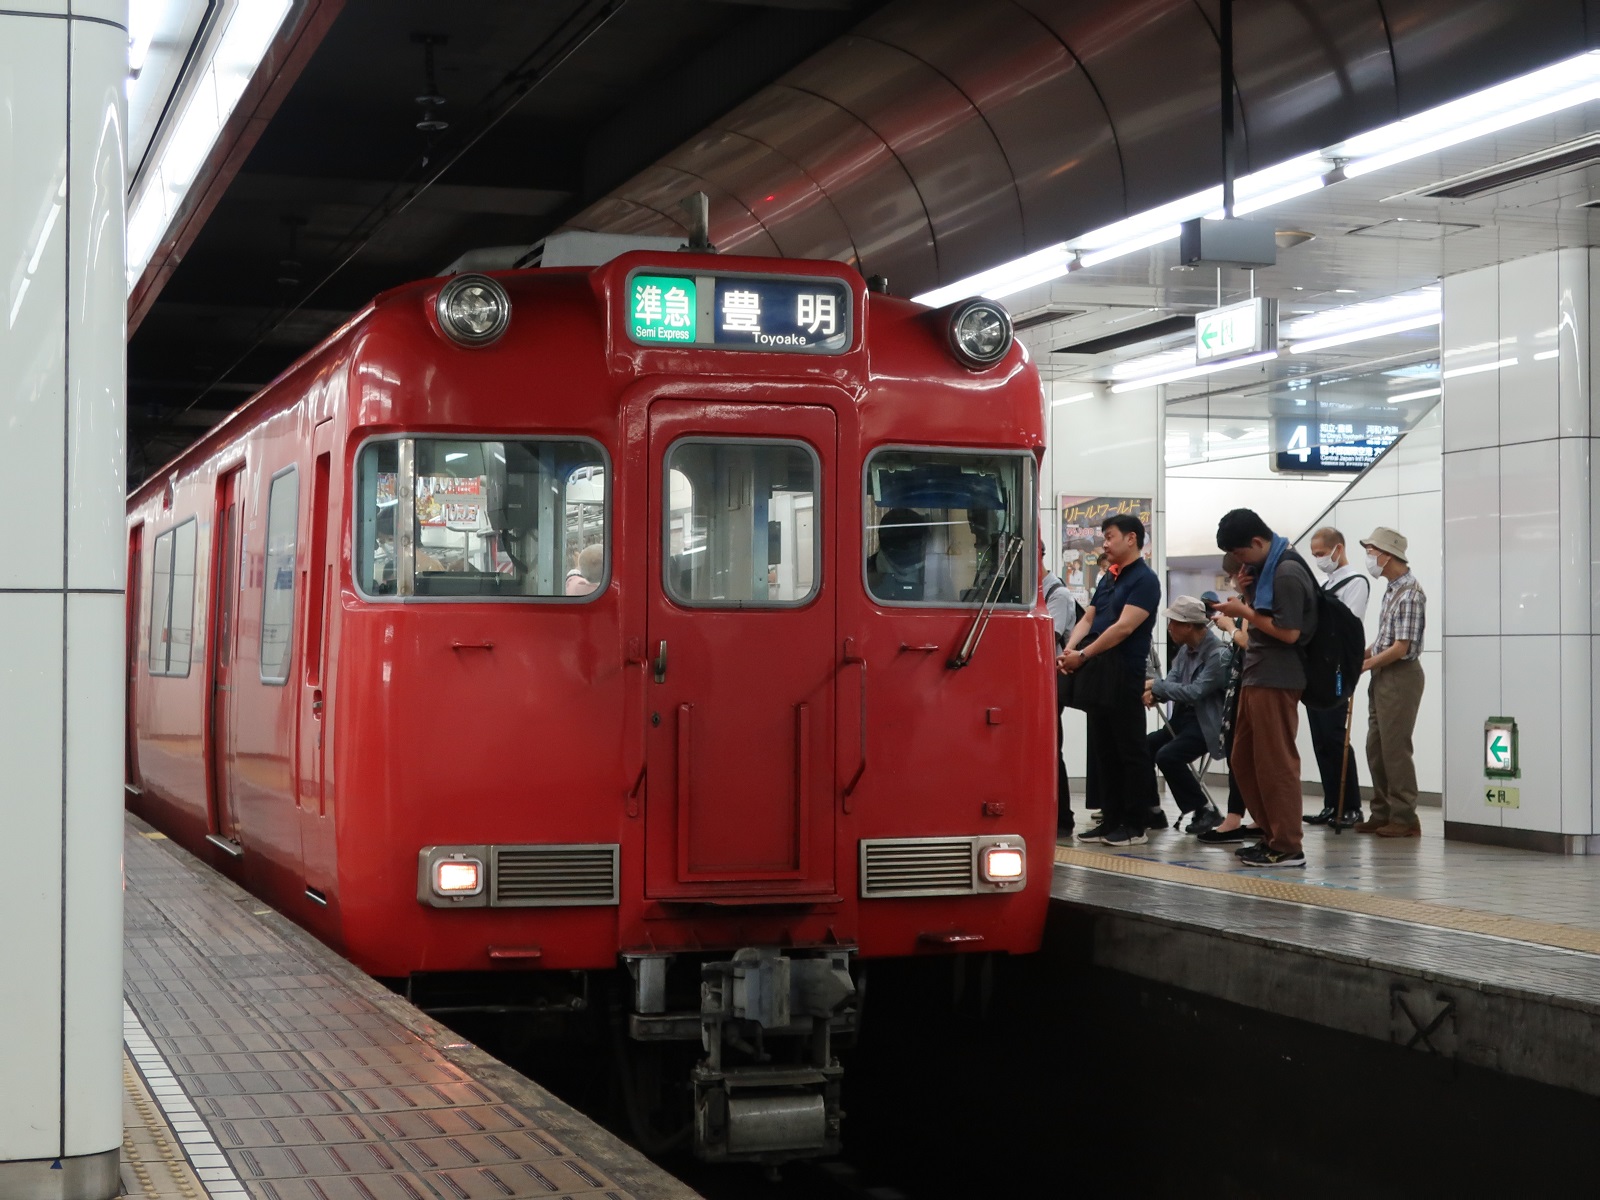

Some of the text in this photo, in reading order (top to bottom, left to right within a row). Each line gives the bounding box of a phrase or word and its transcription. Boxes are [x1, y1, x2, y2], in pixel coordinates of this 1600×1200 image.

[635, 285, 691, 327] 準急
[722, 290, 836, 335] 豊明
[636, 326, 690, 341] Semi Express
[752, 331, 807, 347] Toyoake
[1287, 425, 1311, 463] 4
[1064, 500, 1141, 523] リトルワールド
